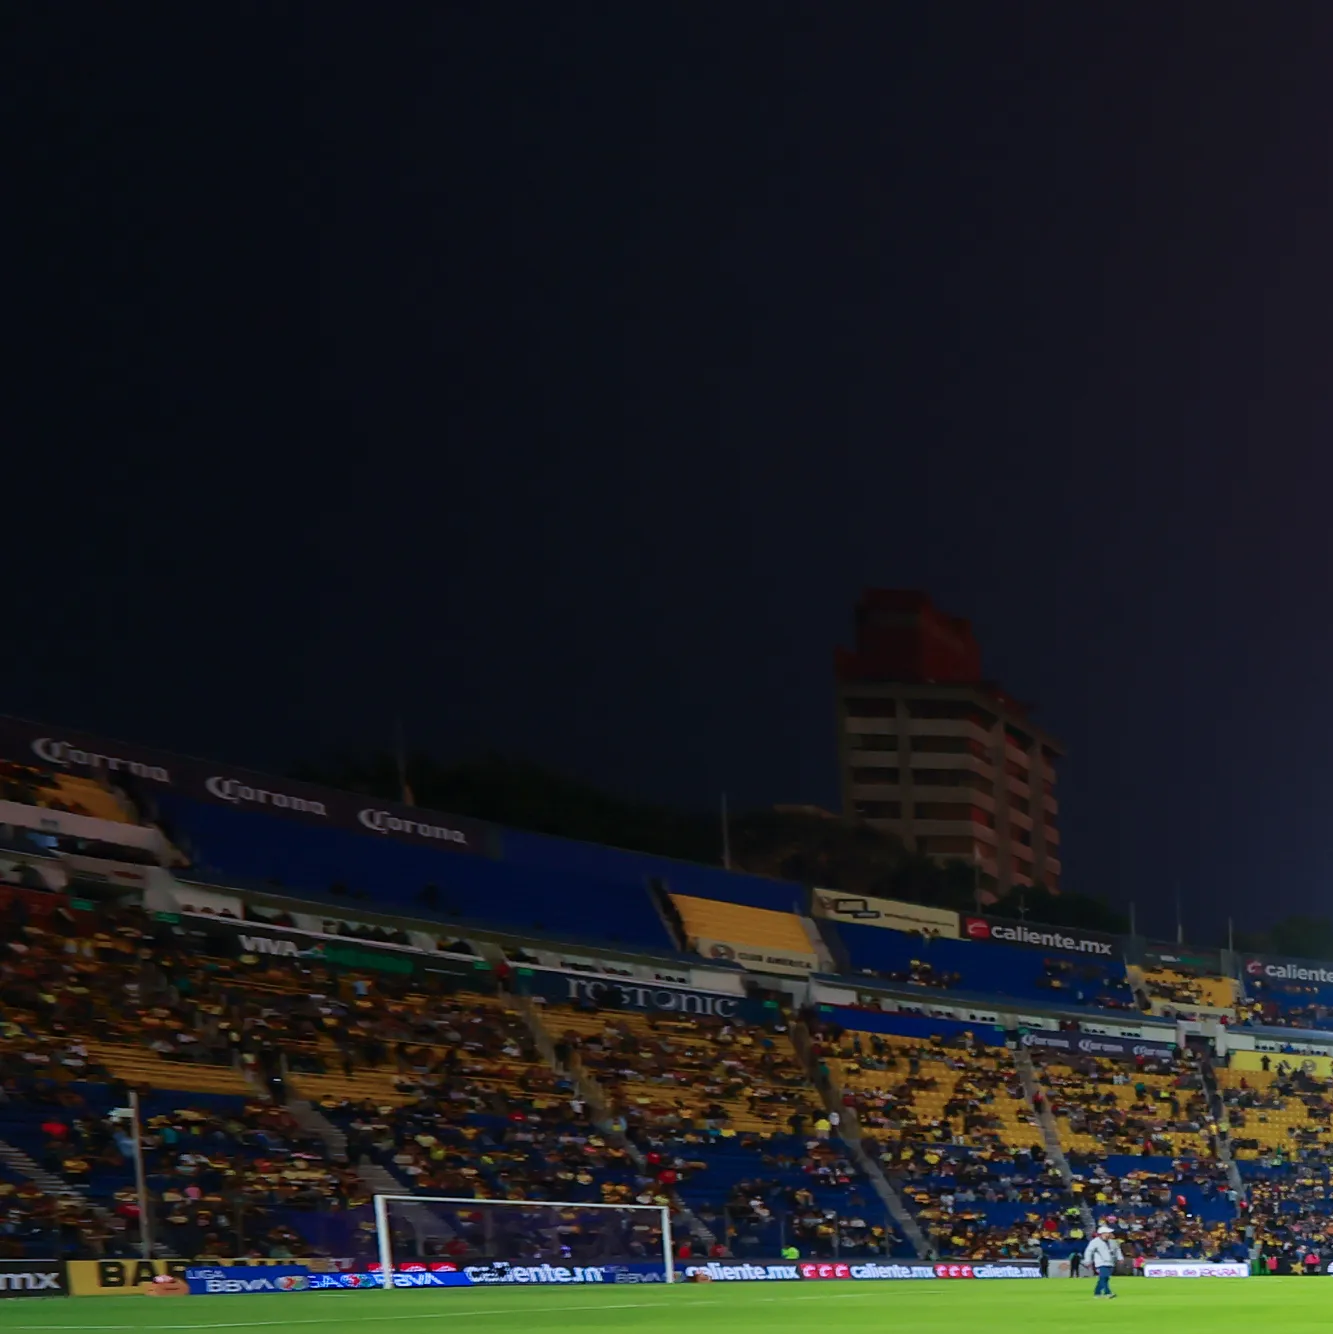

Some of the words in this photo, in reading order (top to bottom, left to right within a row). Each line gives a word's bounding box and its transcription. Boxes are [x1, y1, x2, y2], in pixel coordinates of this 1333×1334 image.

[205, 775, 327, 817] Corona
[357, 807, 468, 846] Corona
[238, 934, 299, 958] VIVA
[990, 926, 1113, 955] caliente.mx
[0, 1271, 61, 1291] mx
[850, 1262, 936, 1280] caliente.mx
[206, 1278, 275, 1292] BBVA
